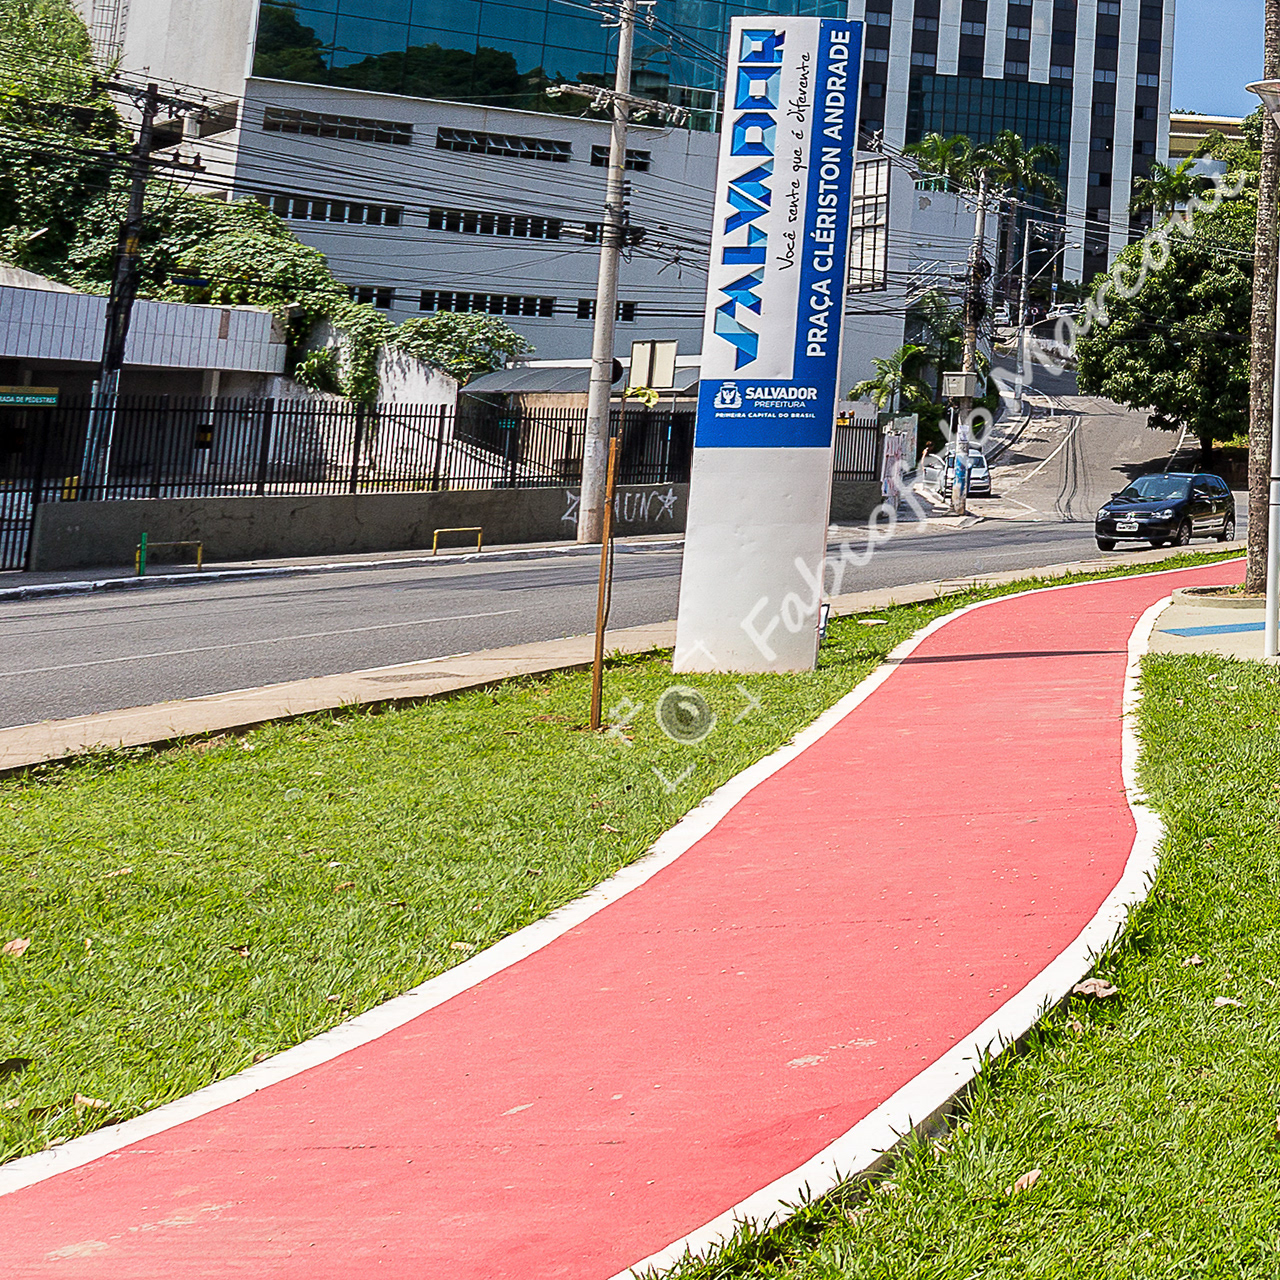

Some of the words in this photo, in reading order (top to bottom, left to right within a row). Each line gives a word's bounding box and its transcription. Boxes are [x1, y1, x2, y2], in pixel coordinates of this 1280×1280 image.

[786, 52, 811, 123] diferente
[822, 30, 851, 141] ANDRADE
[792, 146, 808, 172] que
[713, 28, 786, 372] SALVADOR
[785, 178, 801, 223] sente
[809, 146, 842, 272] CLÉRISTON
[775, 230, 797, 271] Você
[806, 278, 834, 357] PRAÇA
[744, 387, 817, 400] SALVADOR
[754, 400, 806, 408] PREFEITURA
